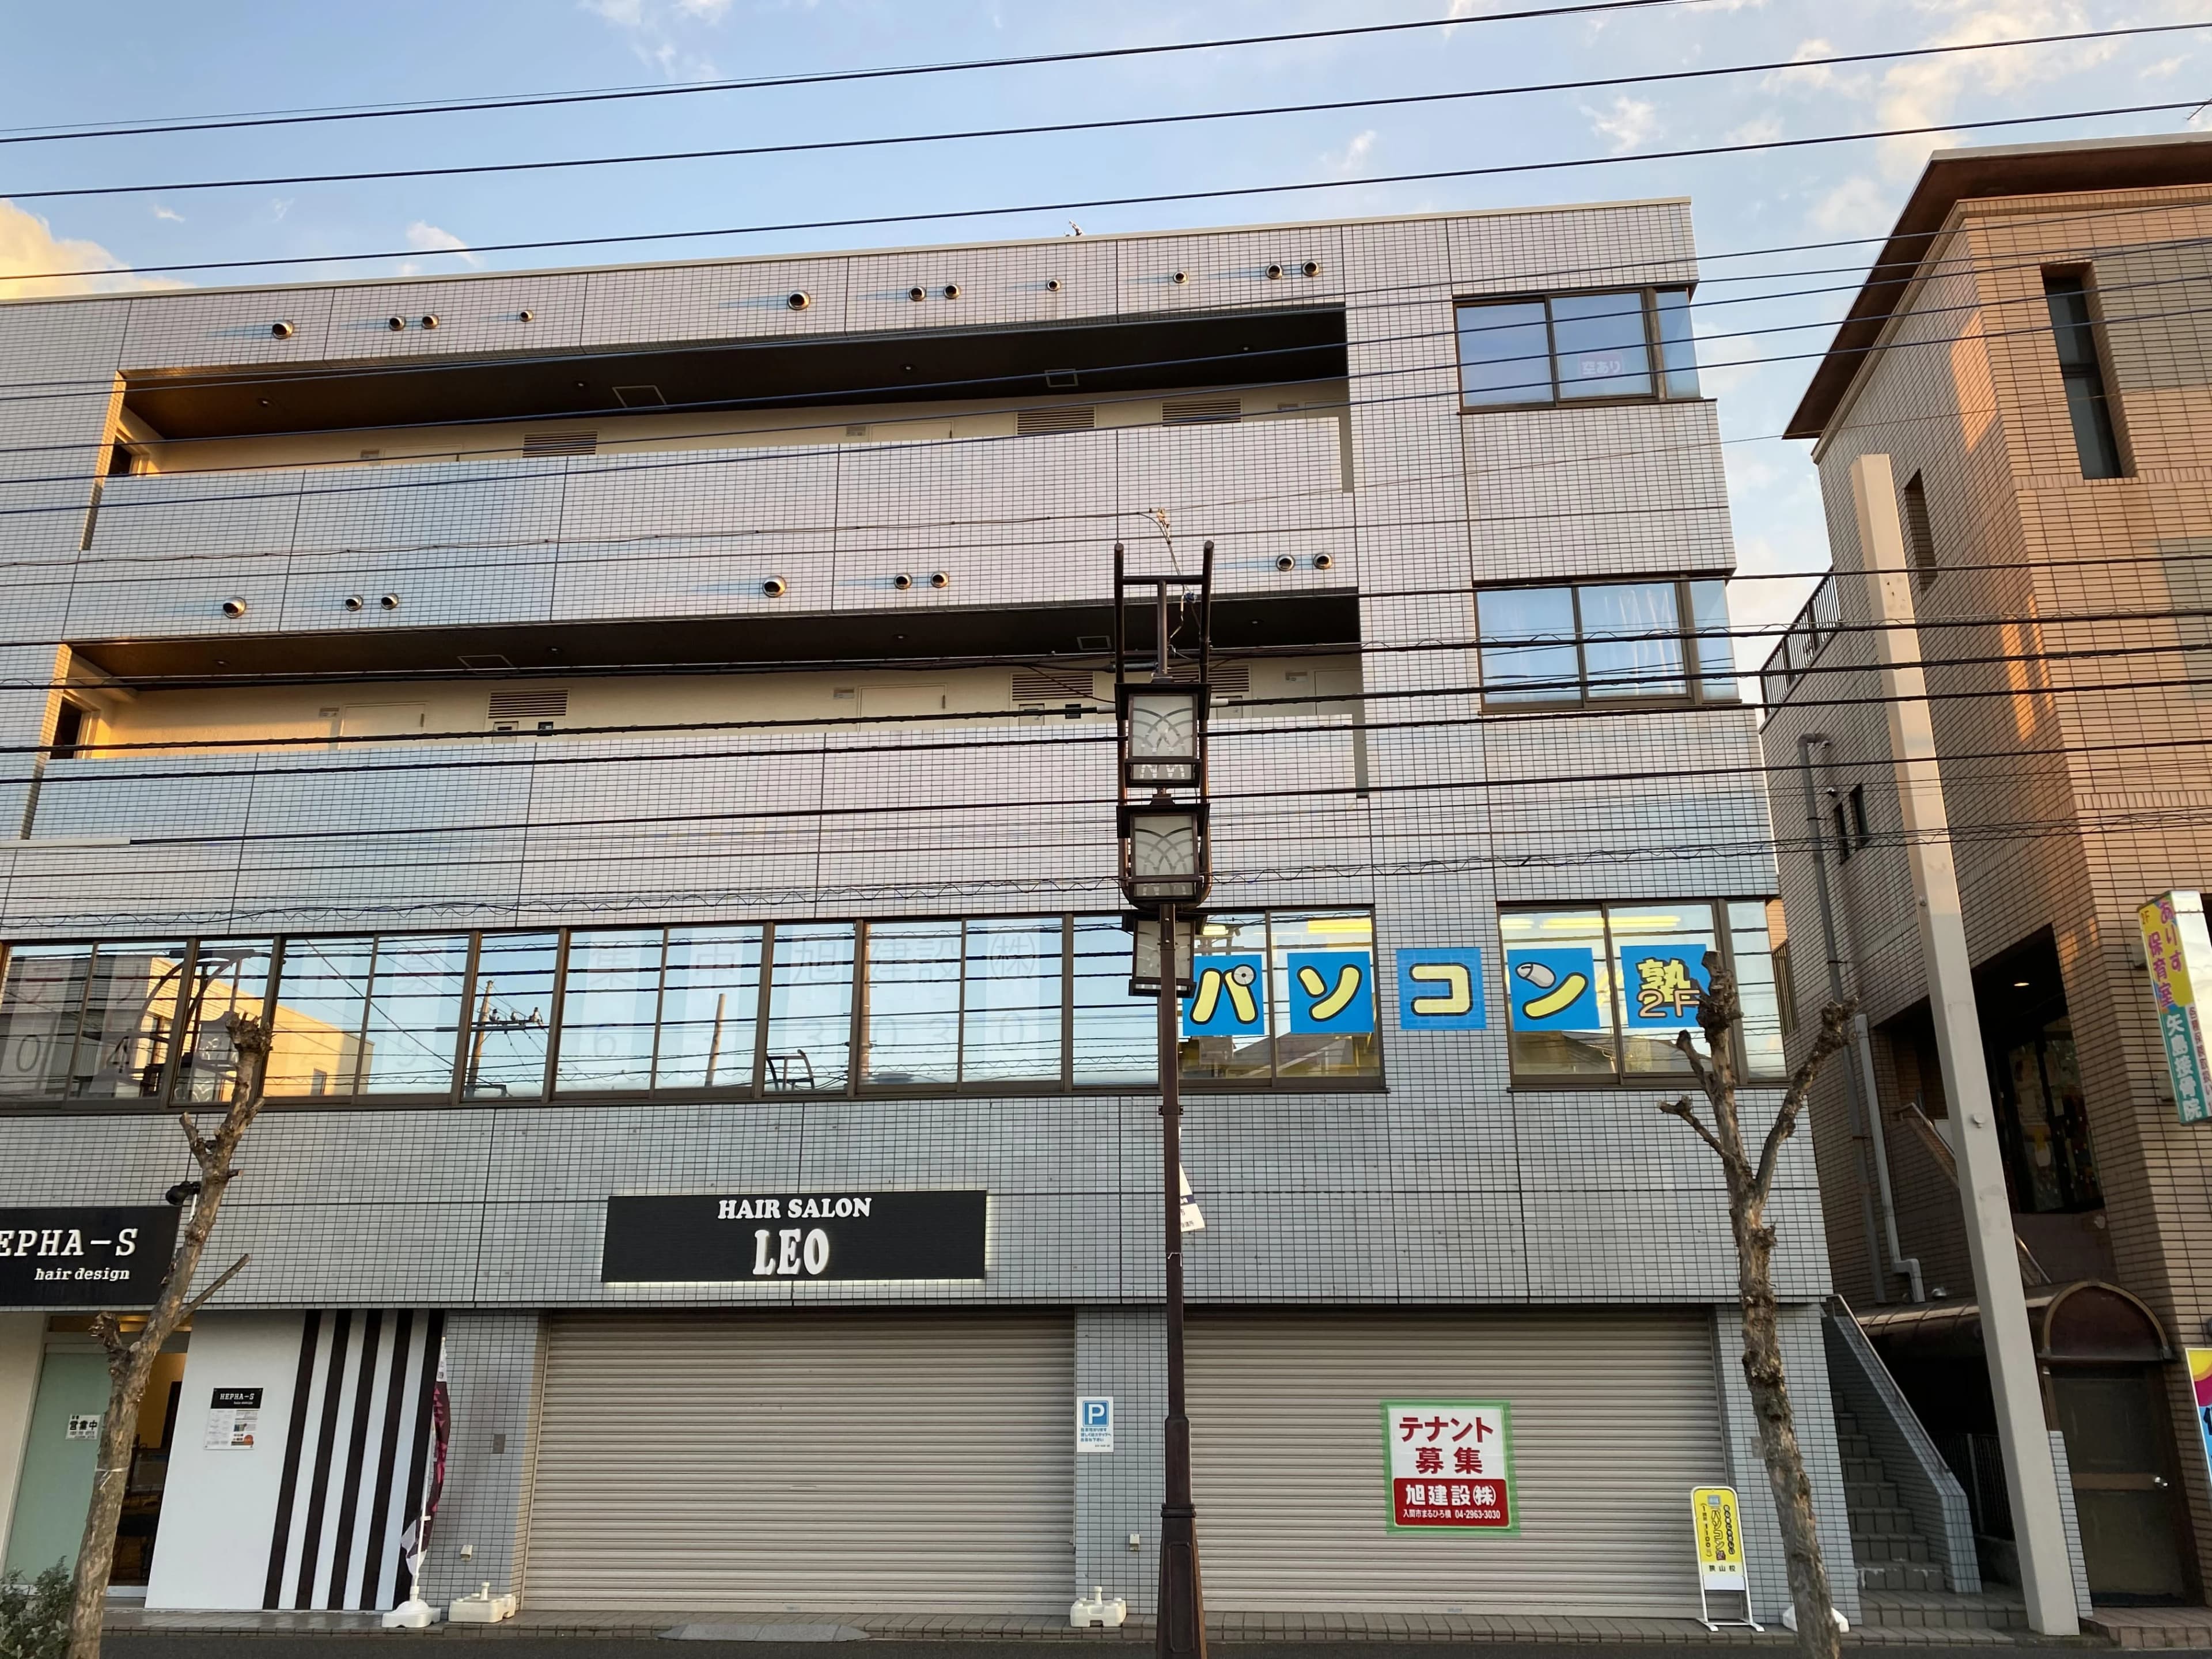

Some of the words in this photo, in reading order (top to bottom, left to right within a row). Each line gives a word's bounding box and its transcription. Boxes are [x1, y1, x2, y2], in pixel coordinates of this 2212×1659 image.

[2160, 901, 2182, 972] ありす
[2148, 931, 2175, 1007] 保育室
[1636, 987, 1701, 1019] 2F
[2166, 1013, 2203, 1122] 矢島接骨院
[717, 1199, 781, 1219] HAIR
[787, 1197, 872, 1219] SALON
[752, 1228, 830, 1275] LEO
[34, 1267, 72, 1281] hair
[74, 1267, 130, 1282] design
[1088, 1403, 1105, 1425] P
[1399, 1415, 1494, 1443] テナント
[1415, 1446, 1483, 1475] 募集
